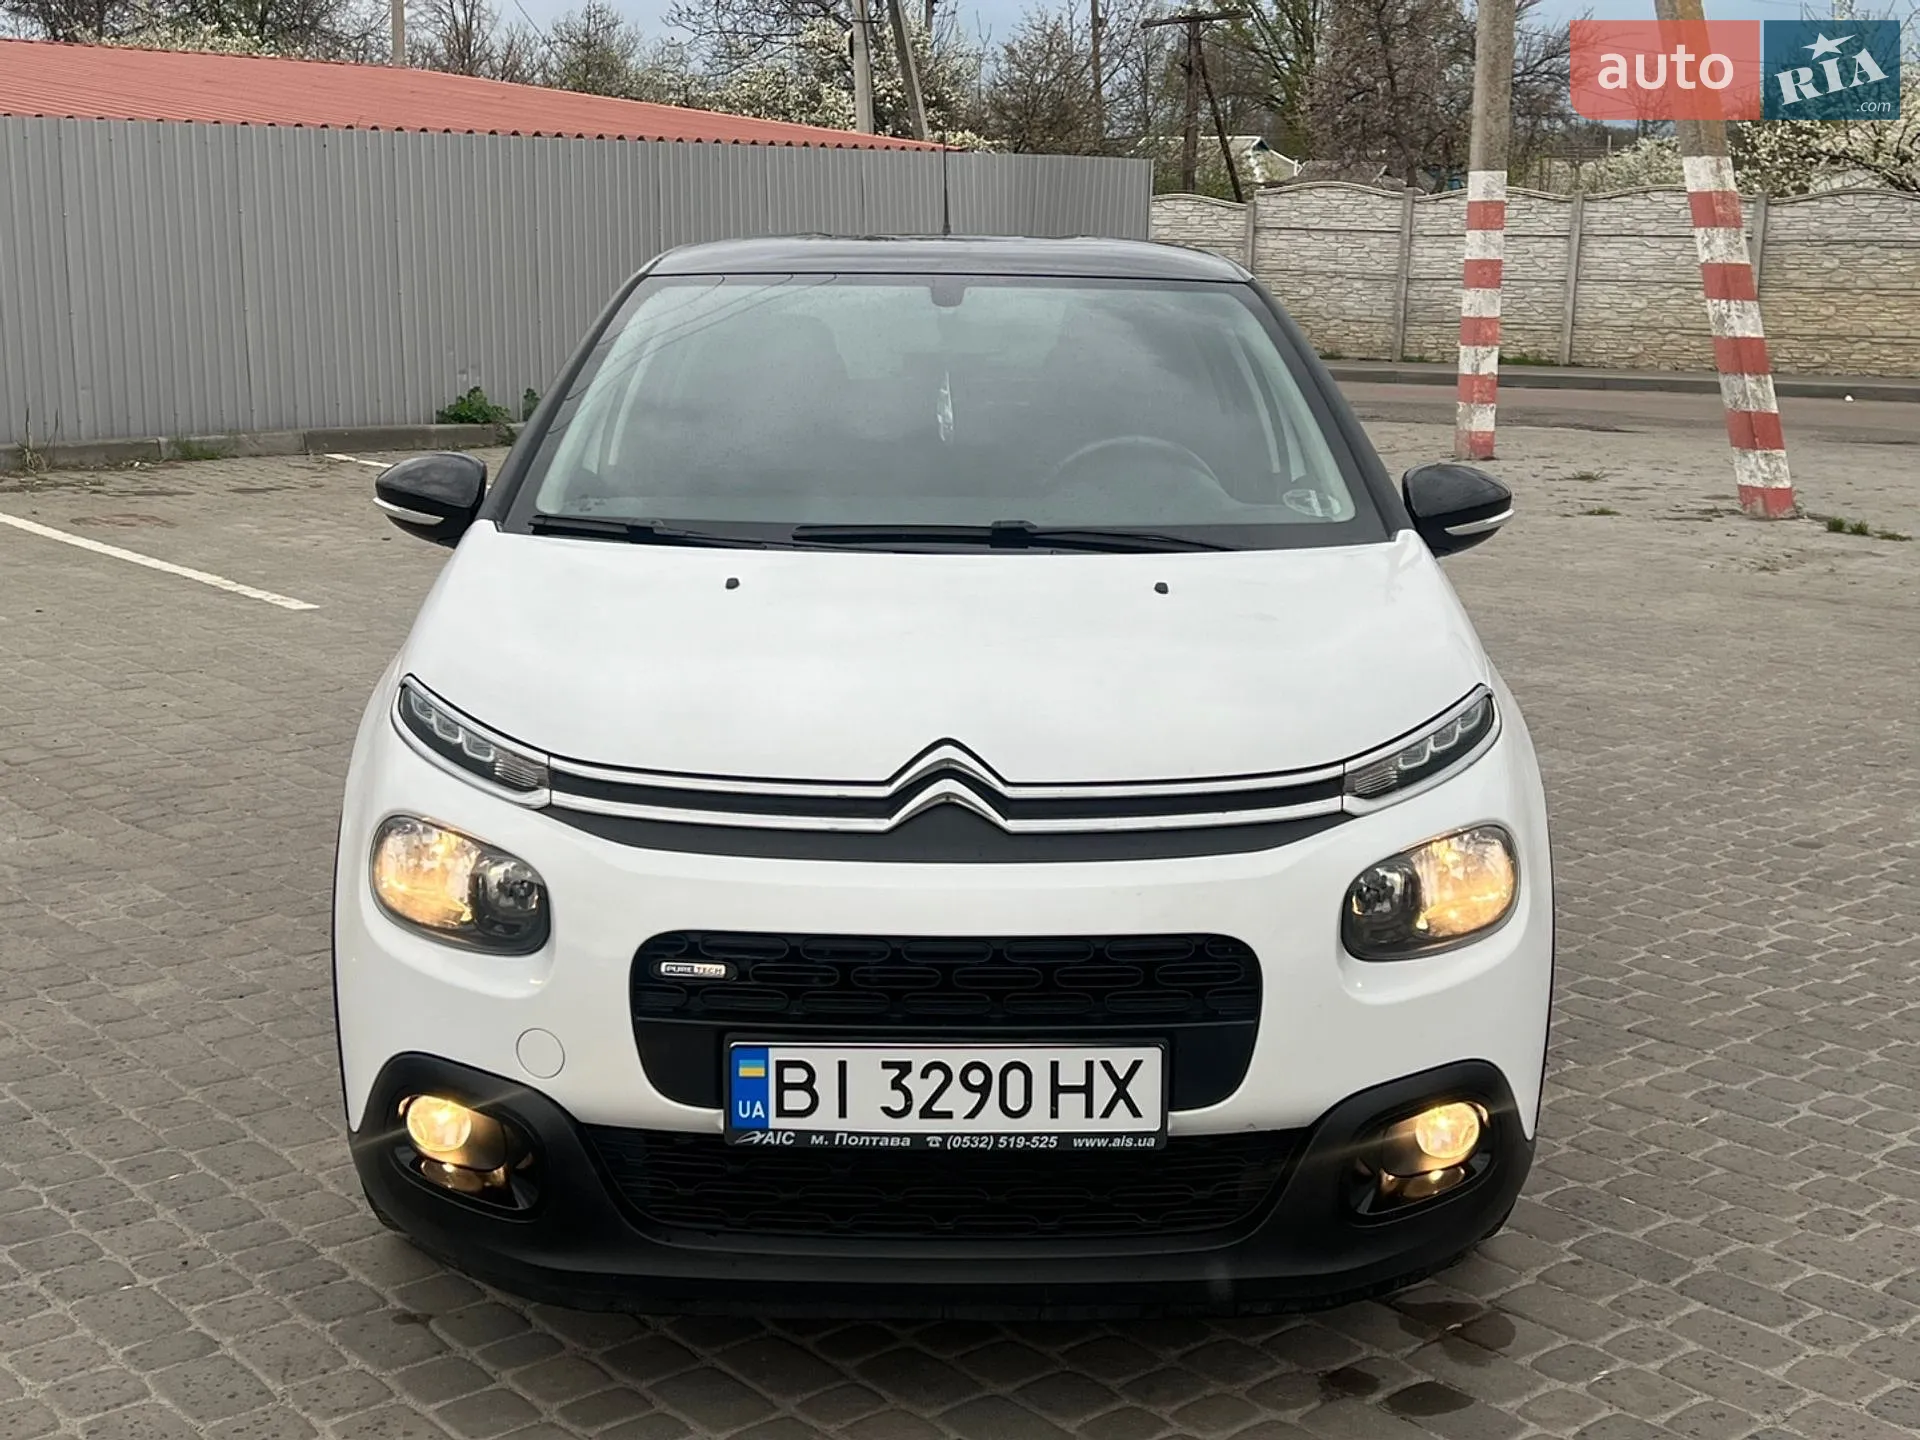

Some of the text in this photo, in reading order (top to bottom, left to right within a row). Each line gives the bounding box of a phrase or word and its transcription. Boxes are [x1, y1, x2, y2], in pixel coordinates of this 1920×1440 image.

[774, 1059, 1145, 1120] BI 3290 HX
[738, 1101, 765, 1119] UA
[834, 1133, 911, 1147] Полтава
[946, 1135, 994, 1150] (0532)
[998, 1135, 1058, 1149] 519-525
[1072, 1134, 1156, 1148] www.ais.ua
